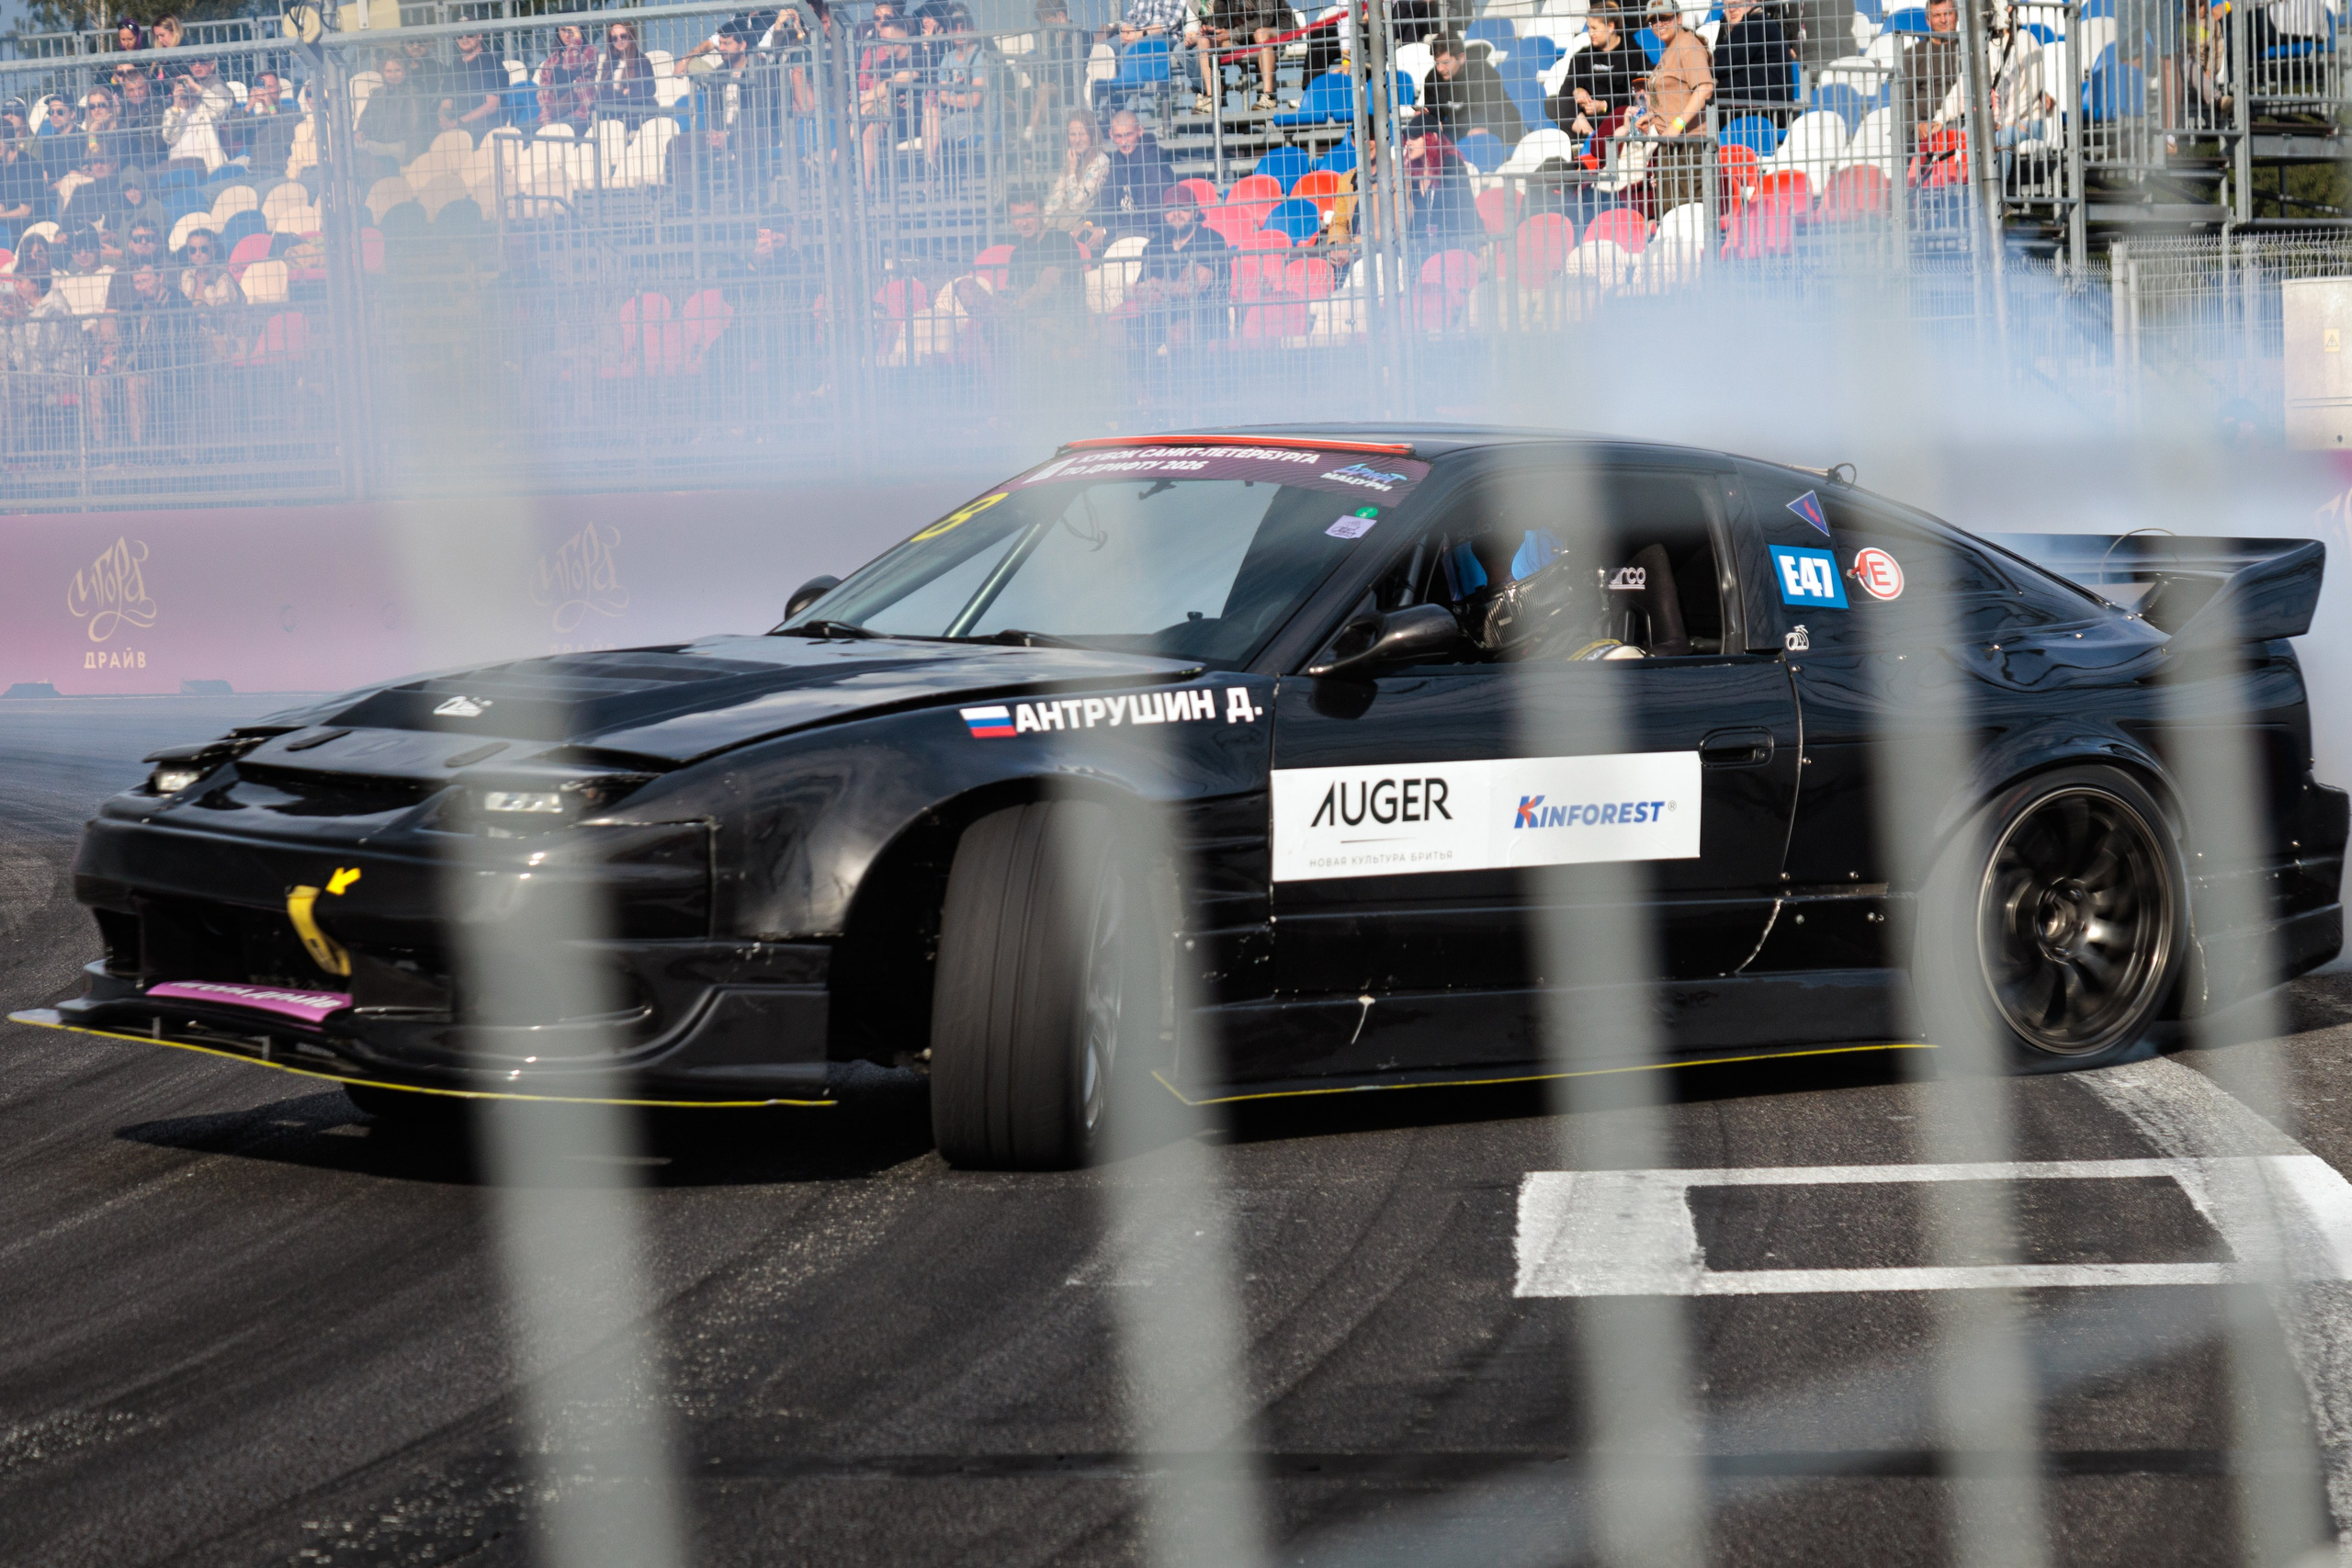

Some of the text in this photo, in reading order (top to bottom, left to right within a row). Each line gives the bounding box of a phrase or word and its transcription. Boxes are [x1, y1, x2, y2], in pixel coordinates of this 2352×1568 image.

[1078, 446, 1320, 464] КУБОК САНКТ-ПЕТЕРБУРГА
[1057, 460, 1209, 477] ПО ДРИФТУ 2026
[1778, 555, 1835, 598] E47
[1868, 561, 1892, 586] E
[84, 647, 146, 669] ДРАЙВ
[1016, 686, 1264, 733] АНТРУШИН Д.
[1310, 777, 1454, 828] AUGER
[1309, 851, 1453, 868] НОВАЯ КУЛЬТУРА БРИТЬЯ
